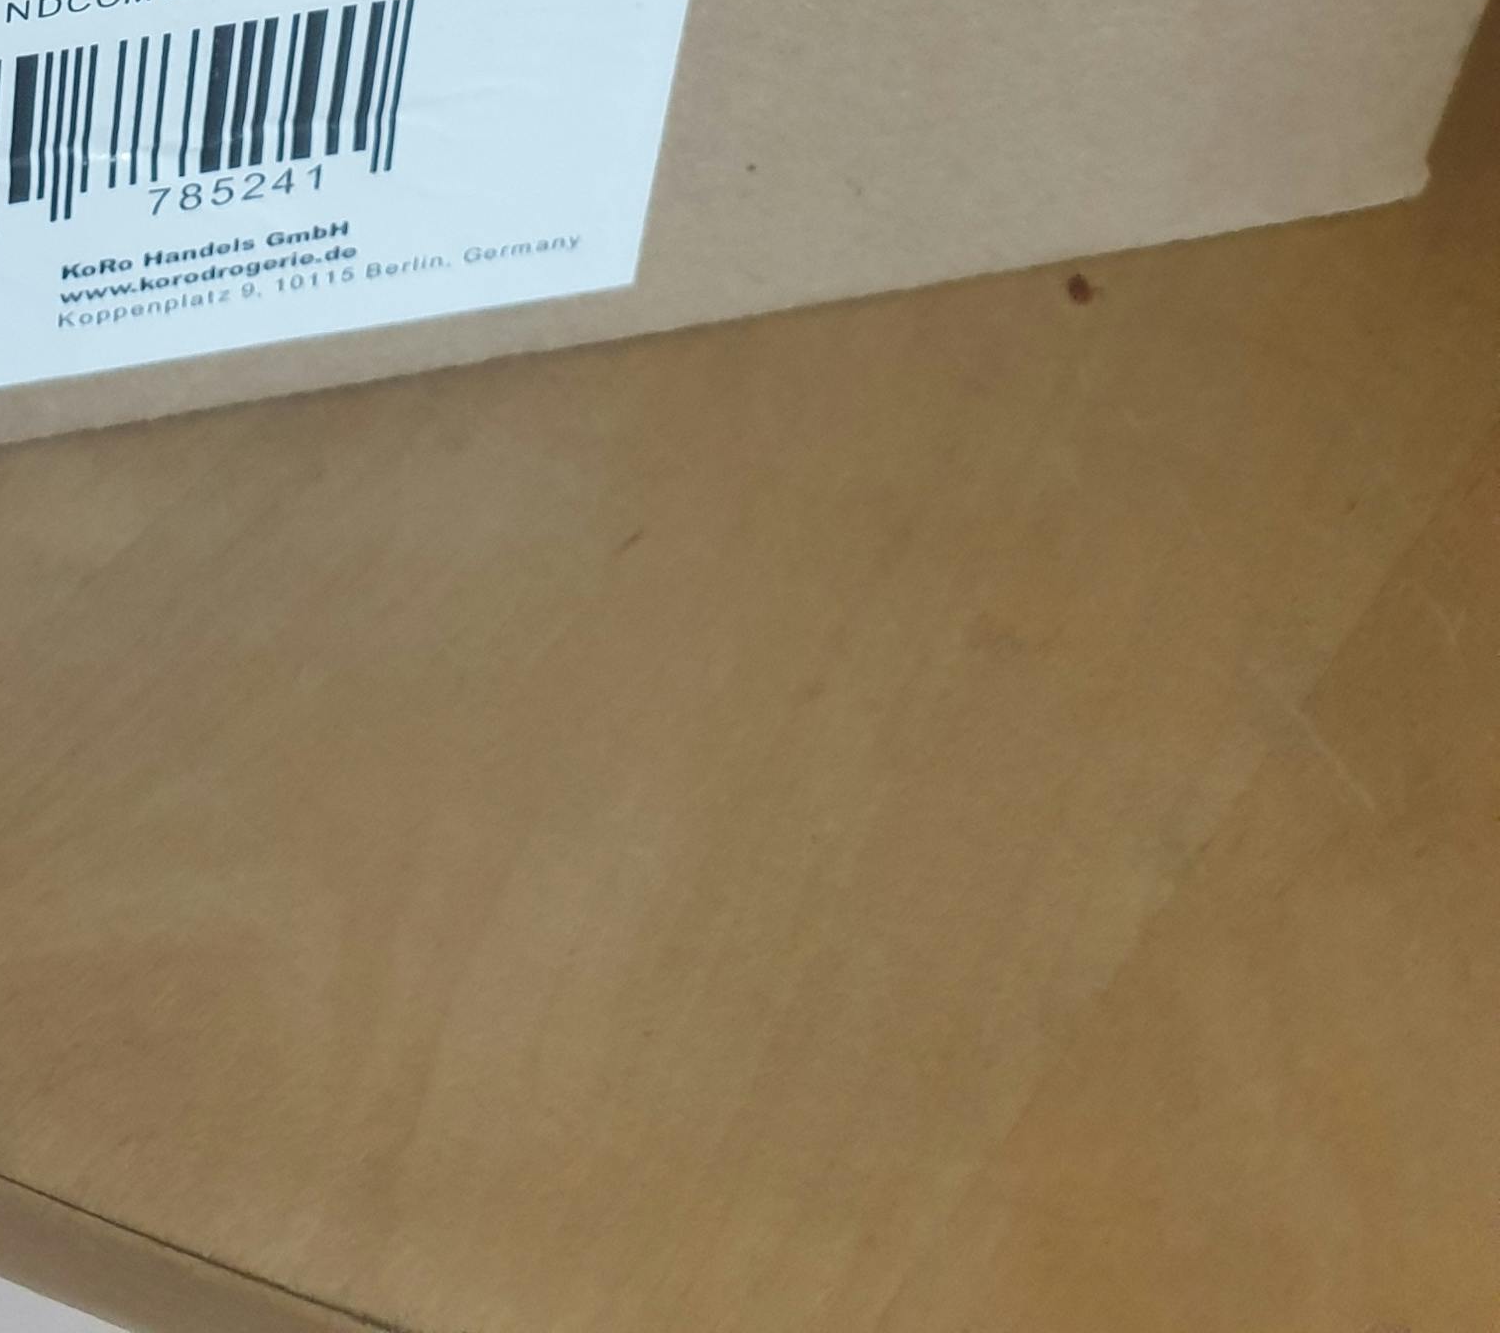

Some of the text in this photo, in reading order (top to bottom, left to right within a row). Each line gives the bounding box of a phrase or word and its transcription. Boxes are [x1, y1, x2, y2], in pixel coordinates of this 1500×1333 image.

[148, 163, 325, 216] 785241
[60, 244, 358, 304] www.korodrogerie.de
[61, 220, 349, 281] KoRo Handels GmbH
[57, 285, 229, 329] Koppenplatz
[276, 265, 355, 293] 10115
[463, 233, 581, 264] Germany
